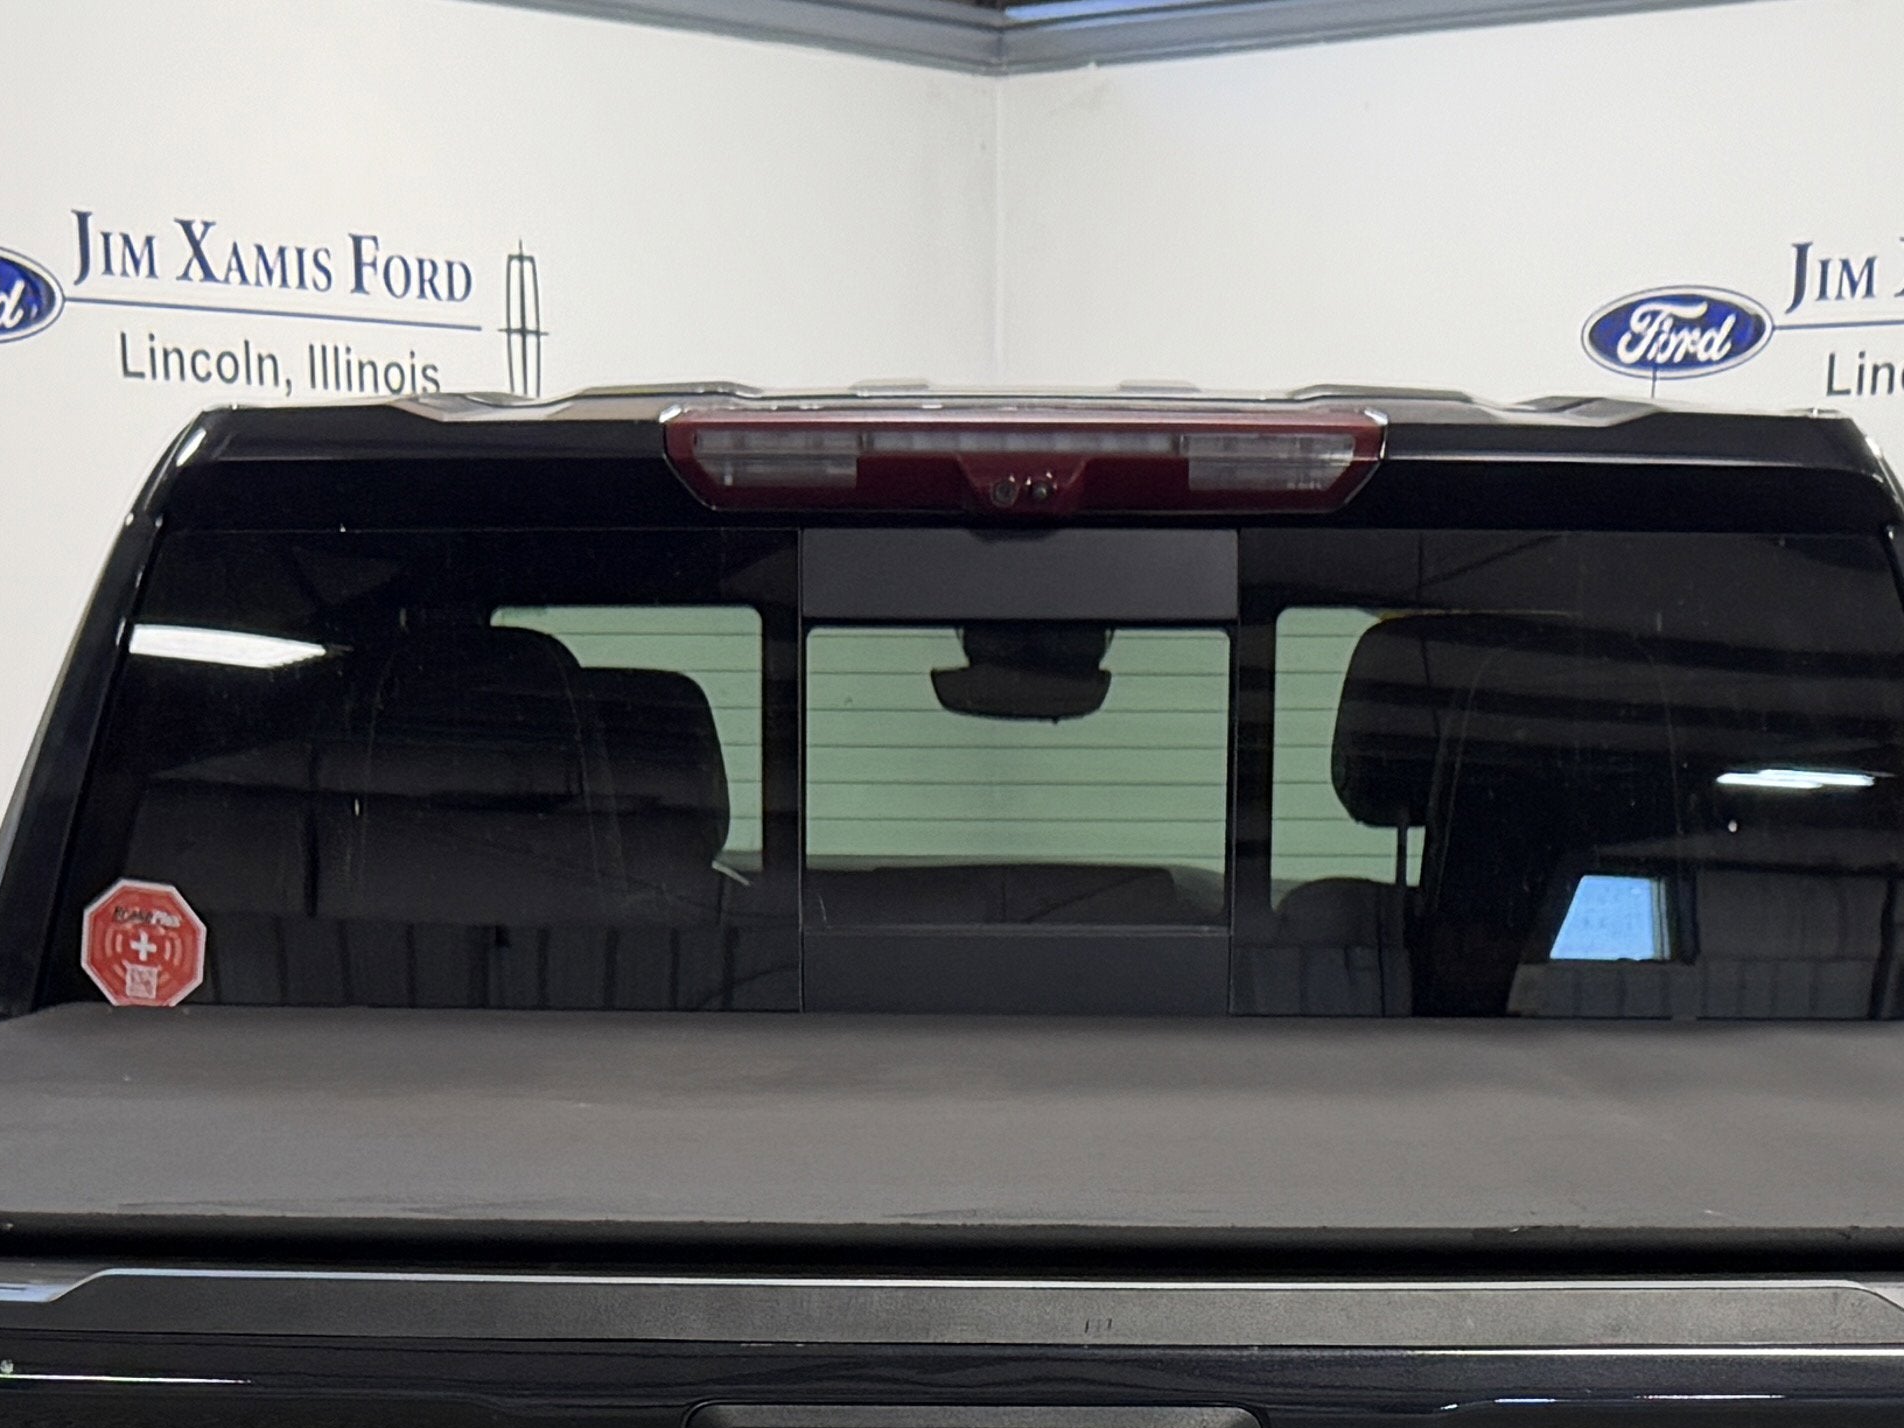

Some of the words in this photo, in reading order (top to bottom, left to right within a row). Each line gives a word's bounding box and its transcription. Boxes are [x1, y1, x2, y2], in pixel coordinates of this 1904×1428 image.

[71, 208, 160, 287] JIM
[174, 217, 334, 292] XAMIS
[347, 232, 472, 301] FORD
[1785, 240, 1878, 314] JIM
[120, 331, 293, 394] Lincoln,
[308, 343, 441, 395] Illinois
[1616, 299, 1737, 363] Ford
